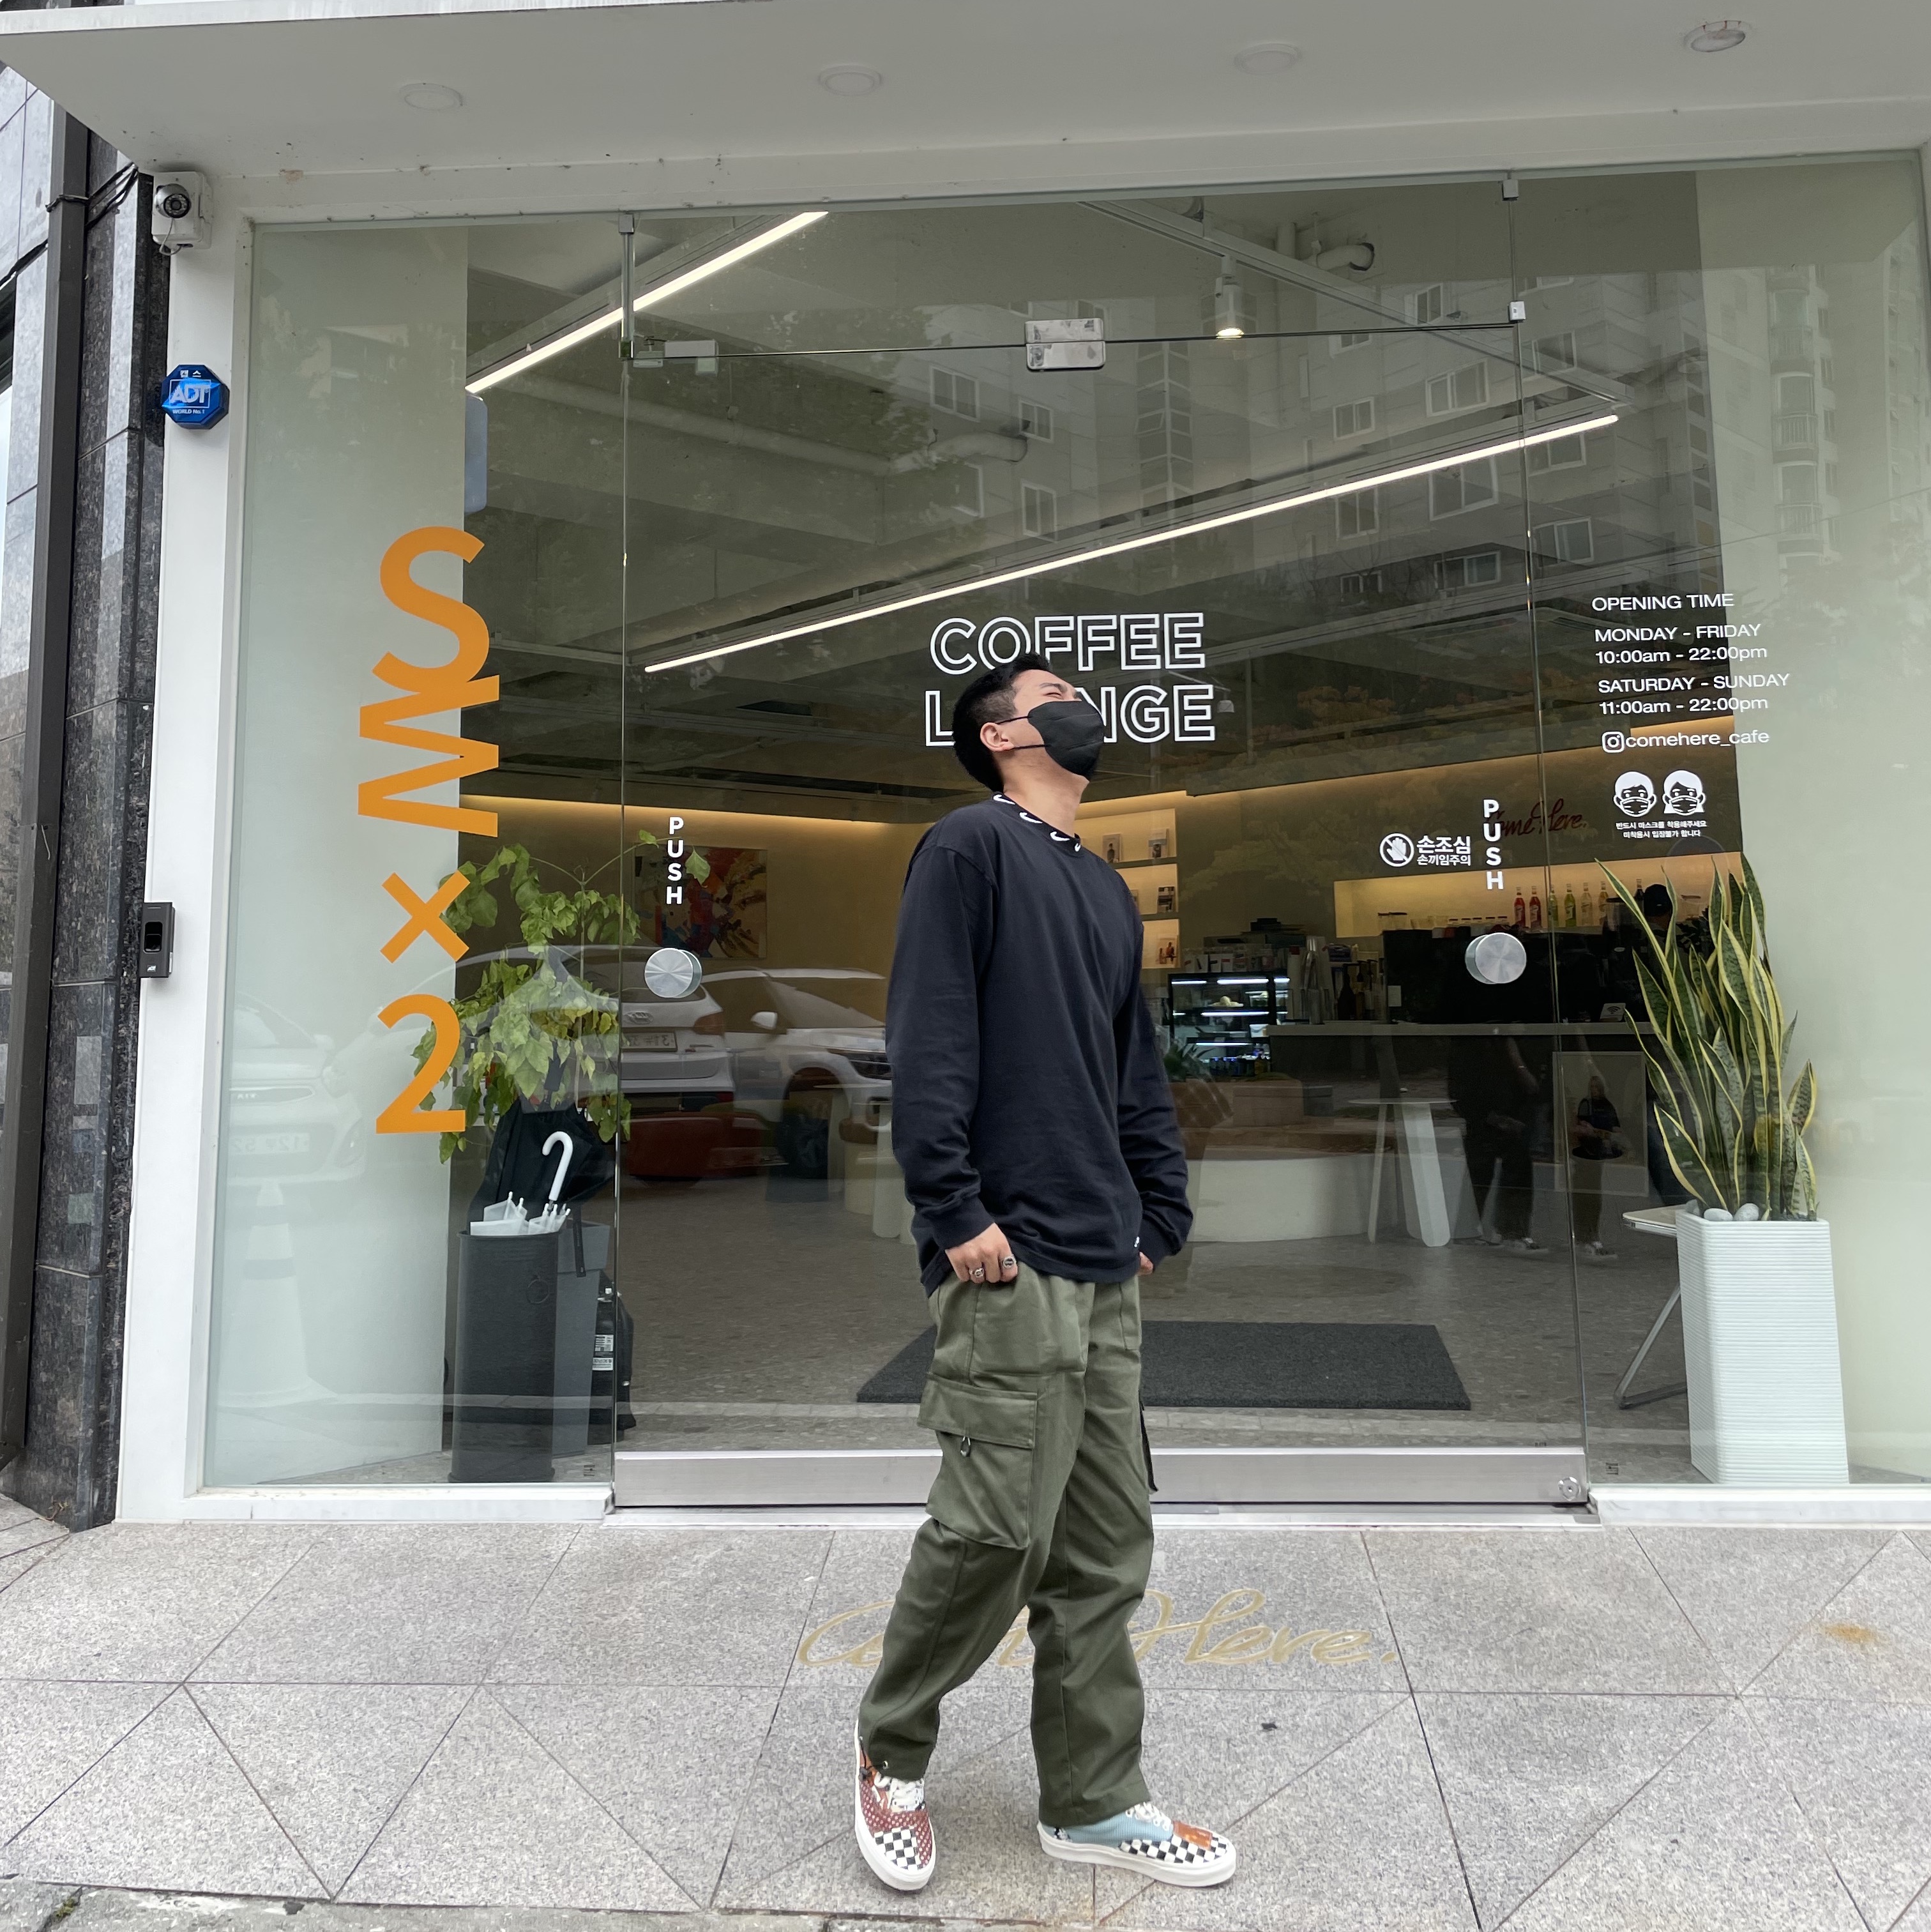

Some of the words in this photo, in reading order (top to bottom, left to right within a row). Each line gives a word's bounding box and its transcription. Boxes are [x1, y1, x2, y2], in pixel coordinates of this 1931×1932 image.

[169, 384, 211, 403] ADT
[1592, 595, 1681, 611] OPENING
[1686, 593, 1734, 607] TIME
[1595, 627, 1679, 642] MONDAY
[1696, 623, 1761, 639] FRIDAY
[930, 612, 1206, 675] COFFEE
[1596, 650, 1670, 664] 10:00am
[1688, 646, 1768, 662] 22:00pm
[1598, 676, 1696, 694] SATURDAY
[1713, 673, 1791, 690] SUNDAY
[1599, 701, 1670, 715] 11:00am
[1689, 697, 1769, 713] 22:00pm
[1625, 730, 1770, 747] comehere_cafe
[1416, 835, 1471, 855] 손조심
[1483, 799, 1504, 890] PUSH
[666, 816, 684, 904] PUSH
[1416, 855, 1471, 866] 손끼임주의
